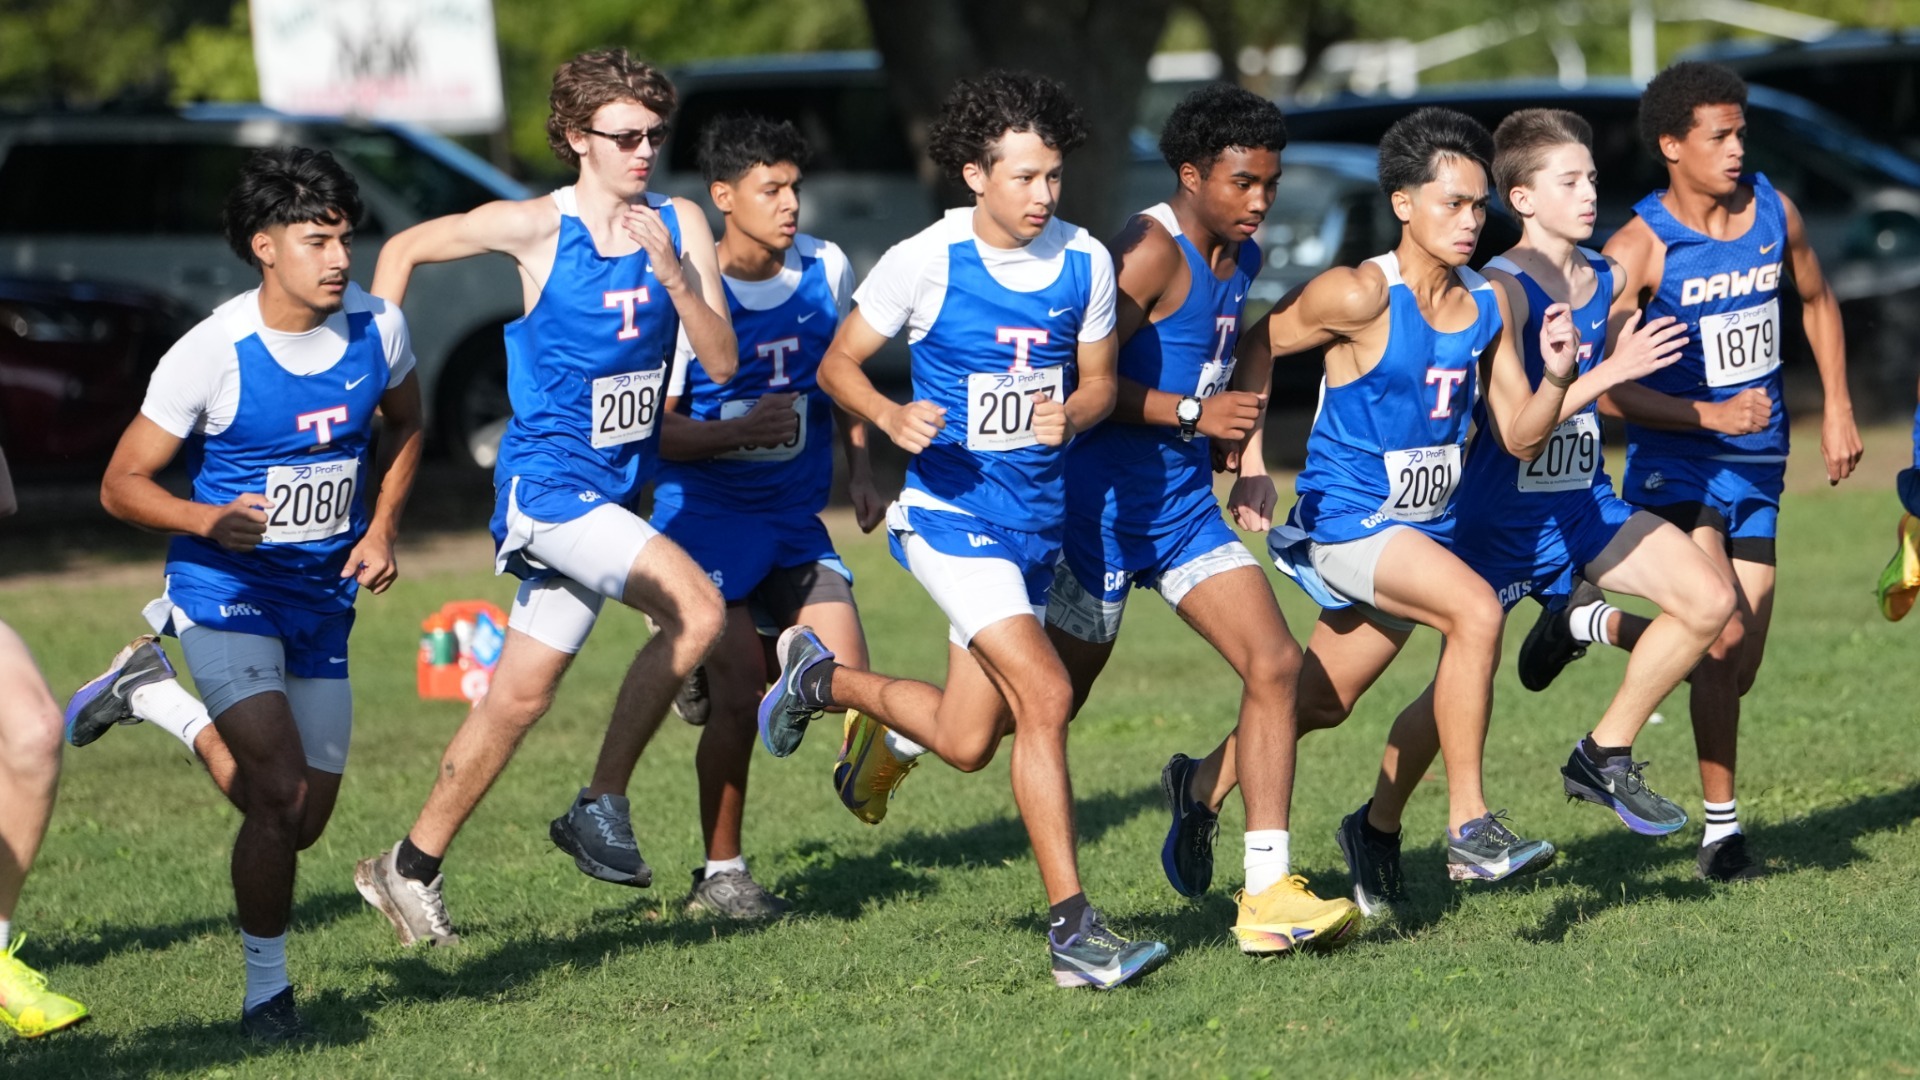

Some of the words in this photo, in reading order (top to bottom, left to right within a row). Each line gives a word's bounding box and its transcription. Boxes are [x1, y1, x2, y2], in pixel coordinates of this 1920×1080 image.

[603, 286, 650, 340] T
[1743, 307, 1768, 320] ProFit
[757, 336, 799, 387] T
[996, 326, 1050, 373] T
[1213, 315, 1237, 366] T
[1716, 318, 1774, 370] 1879
[633, 371, 661, 382] ProFit
[1018, 372, 1045, 383] ProFit
[1425, 368, 1468, 420] T
[296, 403, 349, 453] T
[600, 385, 663, 433] 208
[315, 464, 343, 475] ProFit
[1426, 449, 1446, 459] ProFit
[1526, 430, 1594, 478] 2079
[269, 477, 353, 526] 2080
[1394, 462, 1452, 509] 2081
[1498, 580, 1532, 607] CATS
